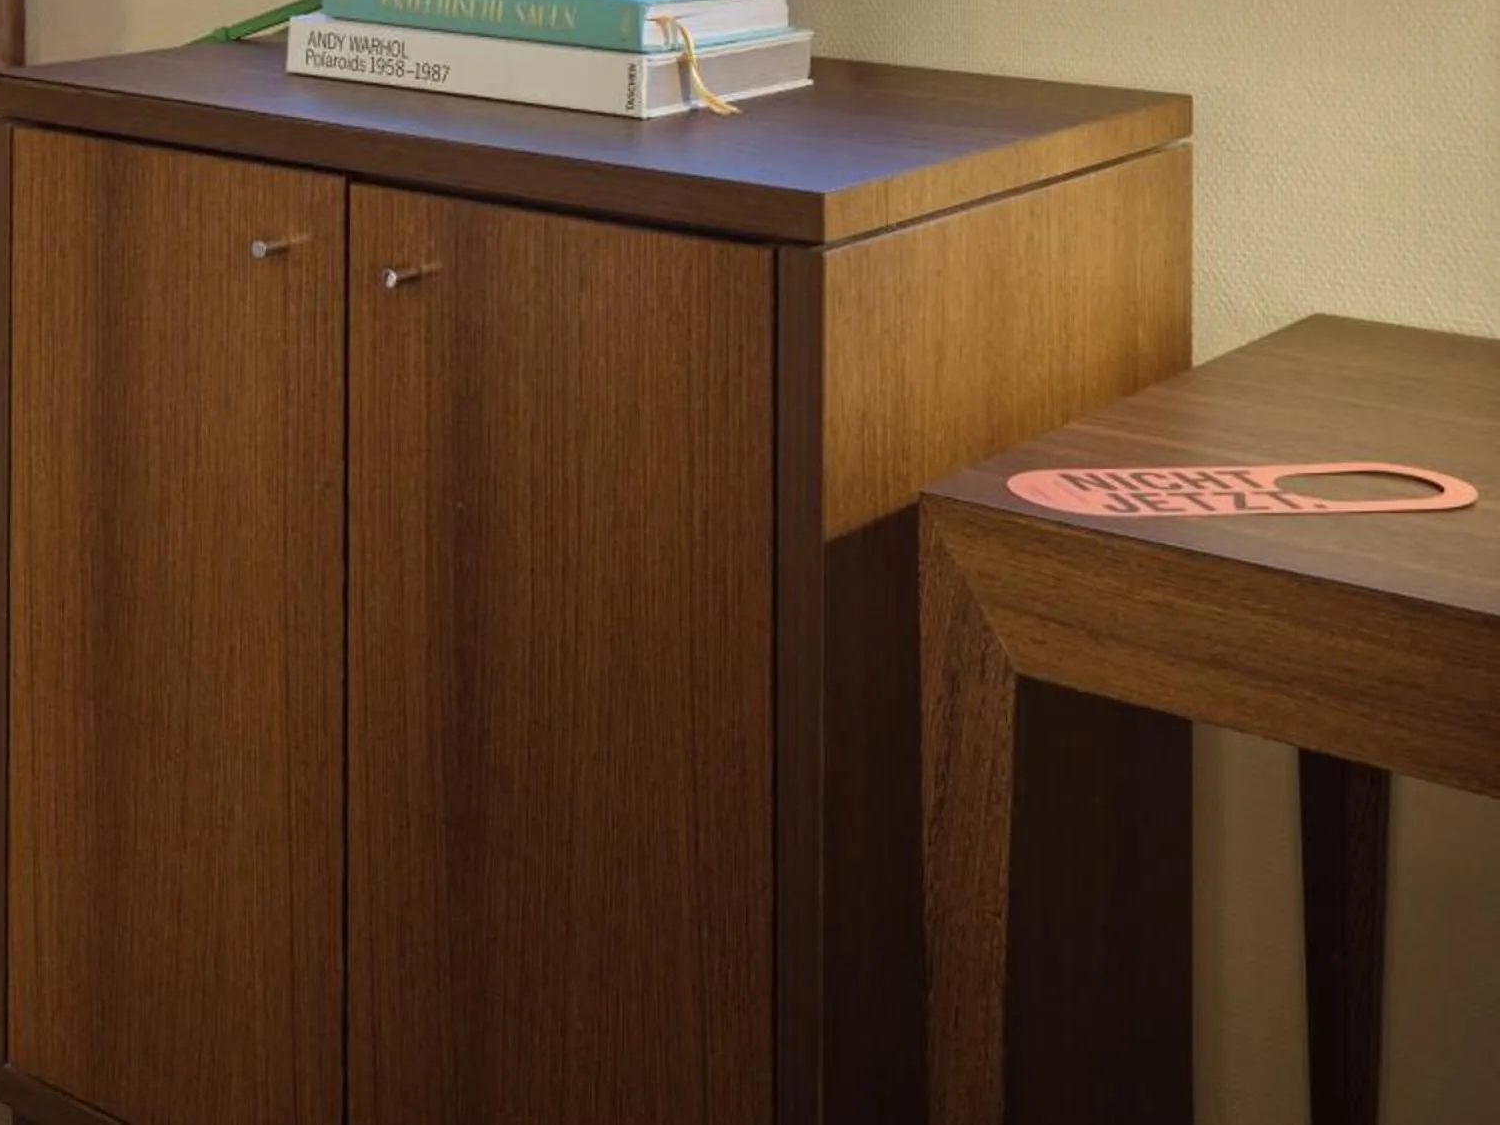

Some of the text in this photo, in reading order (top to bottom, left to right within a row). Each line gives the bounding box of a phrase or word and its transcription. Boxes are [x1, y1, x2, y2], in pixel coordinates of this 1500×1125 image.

[307, 30, 409, 60] ANDY WARHOL
[305, 49, 367, 73] Polaroids
[1059, 470, 1264, 492] NICHT
[1102, 491, 1328, 514] JETZT.
